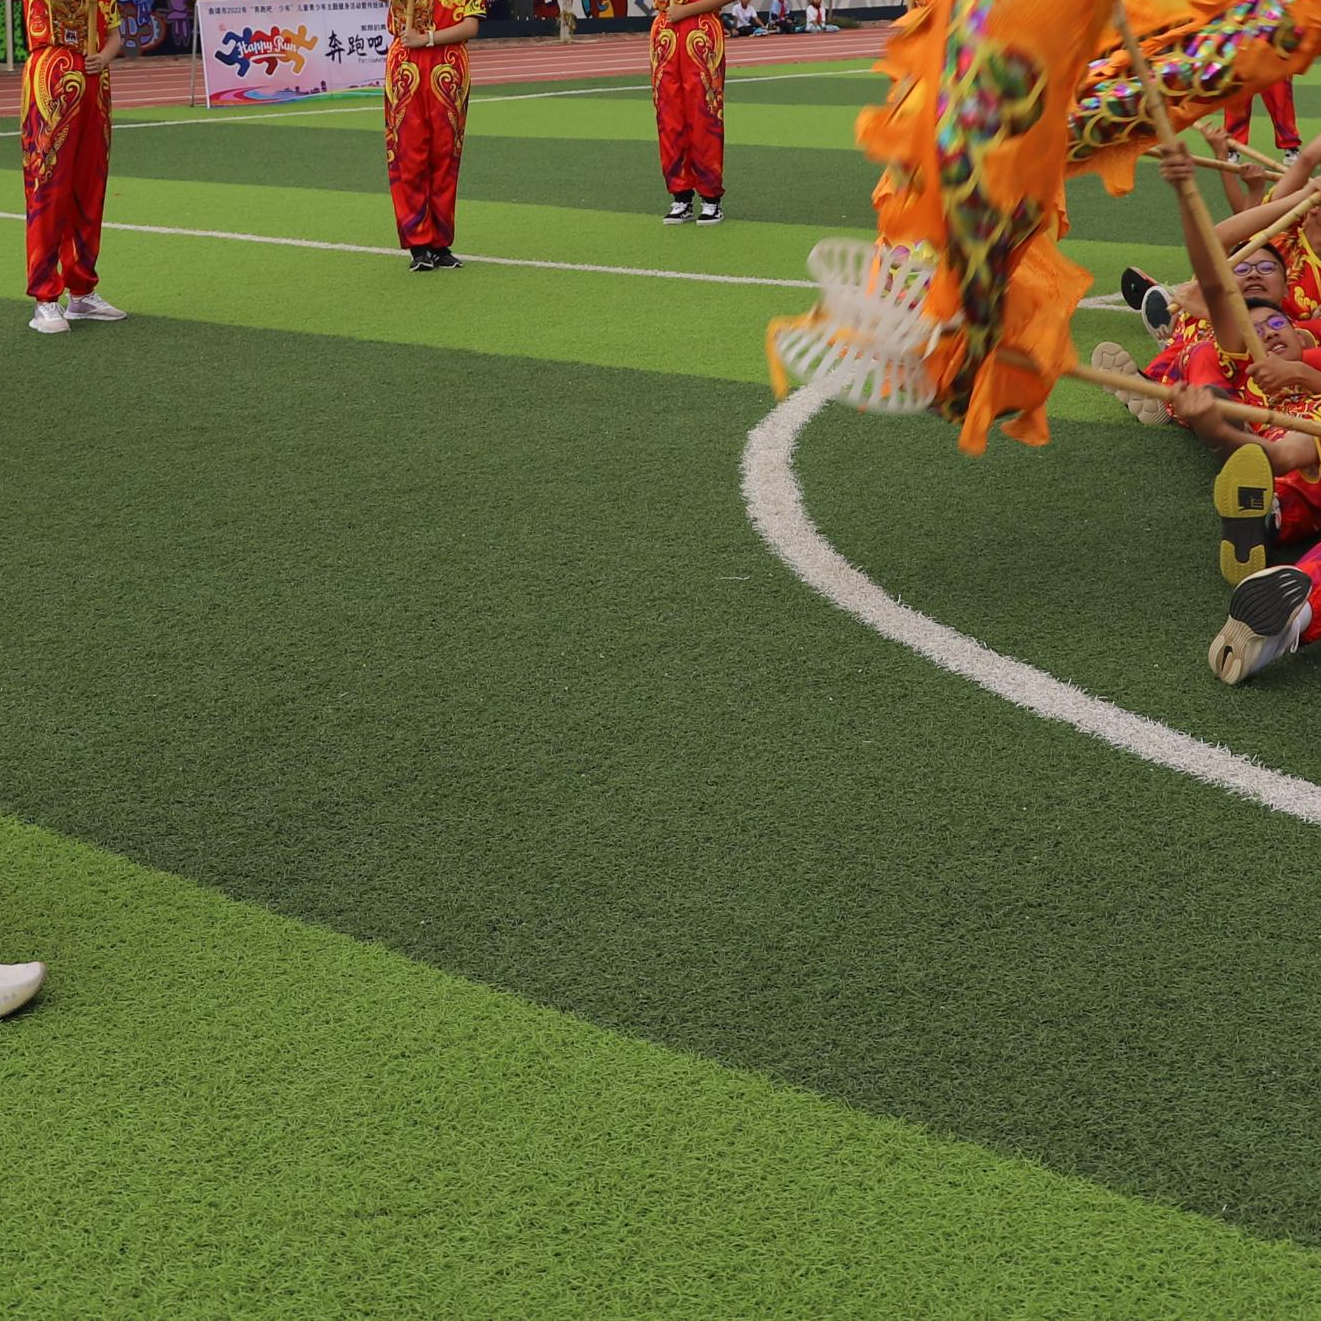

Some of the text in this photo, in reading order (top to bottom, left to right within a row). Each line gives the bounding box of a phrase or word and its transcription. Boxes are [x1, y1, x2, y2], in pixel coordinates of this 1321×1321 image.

[236, 35, 297, 58] Happy Run
[325, 30, 388, 64] 奔跑吧
